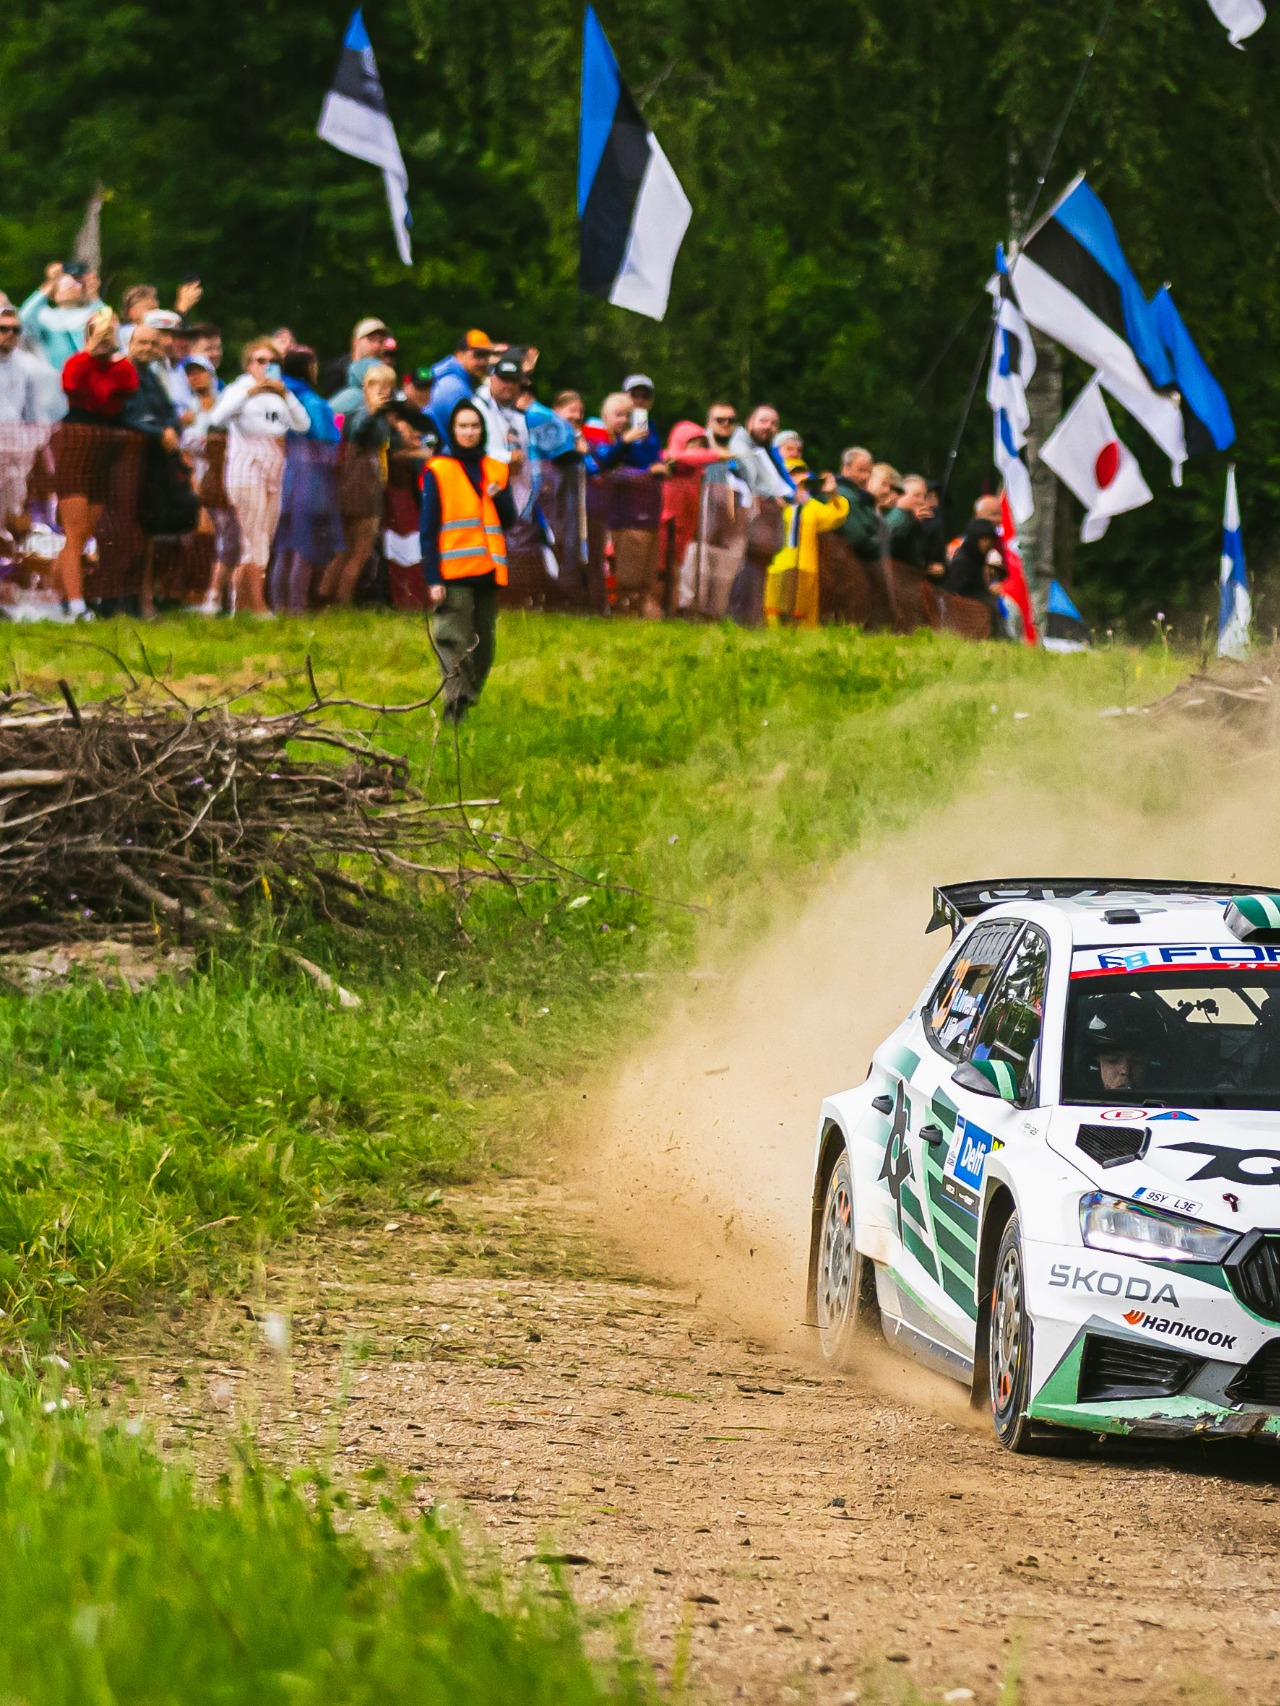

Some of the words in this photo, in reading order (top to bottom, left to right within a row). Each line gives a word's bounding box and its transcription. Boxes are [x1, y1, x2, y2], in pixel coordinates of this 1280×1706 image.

[960, 1136, 987, 1176] Delfi
[1146, 1191, 1169, 1203] 9SY
[1048, 1263, 1180, 1308] SKODA
